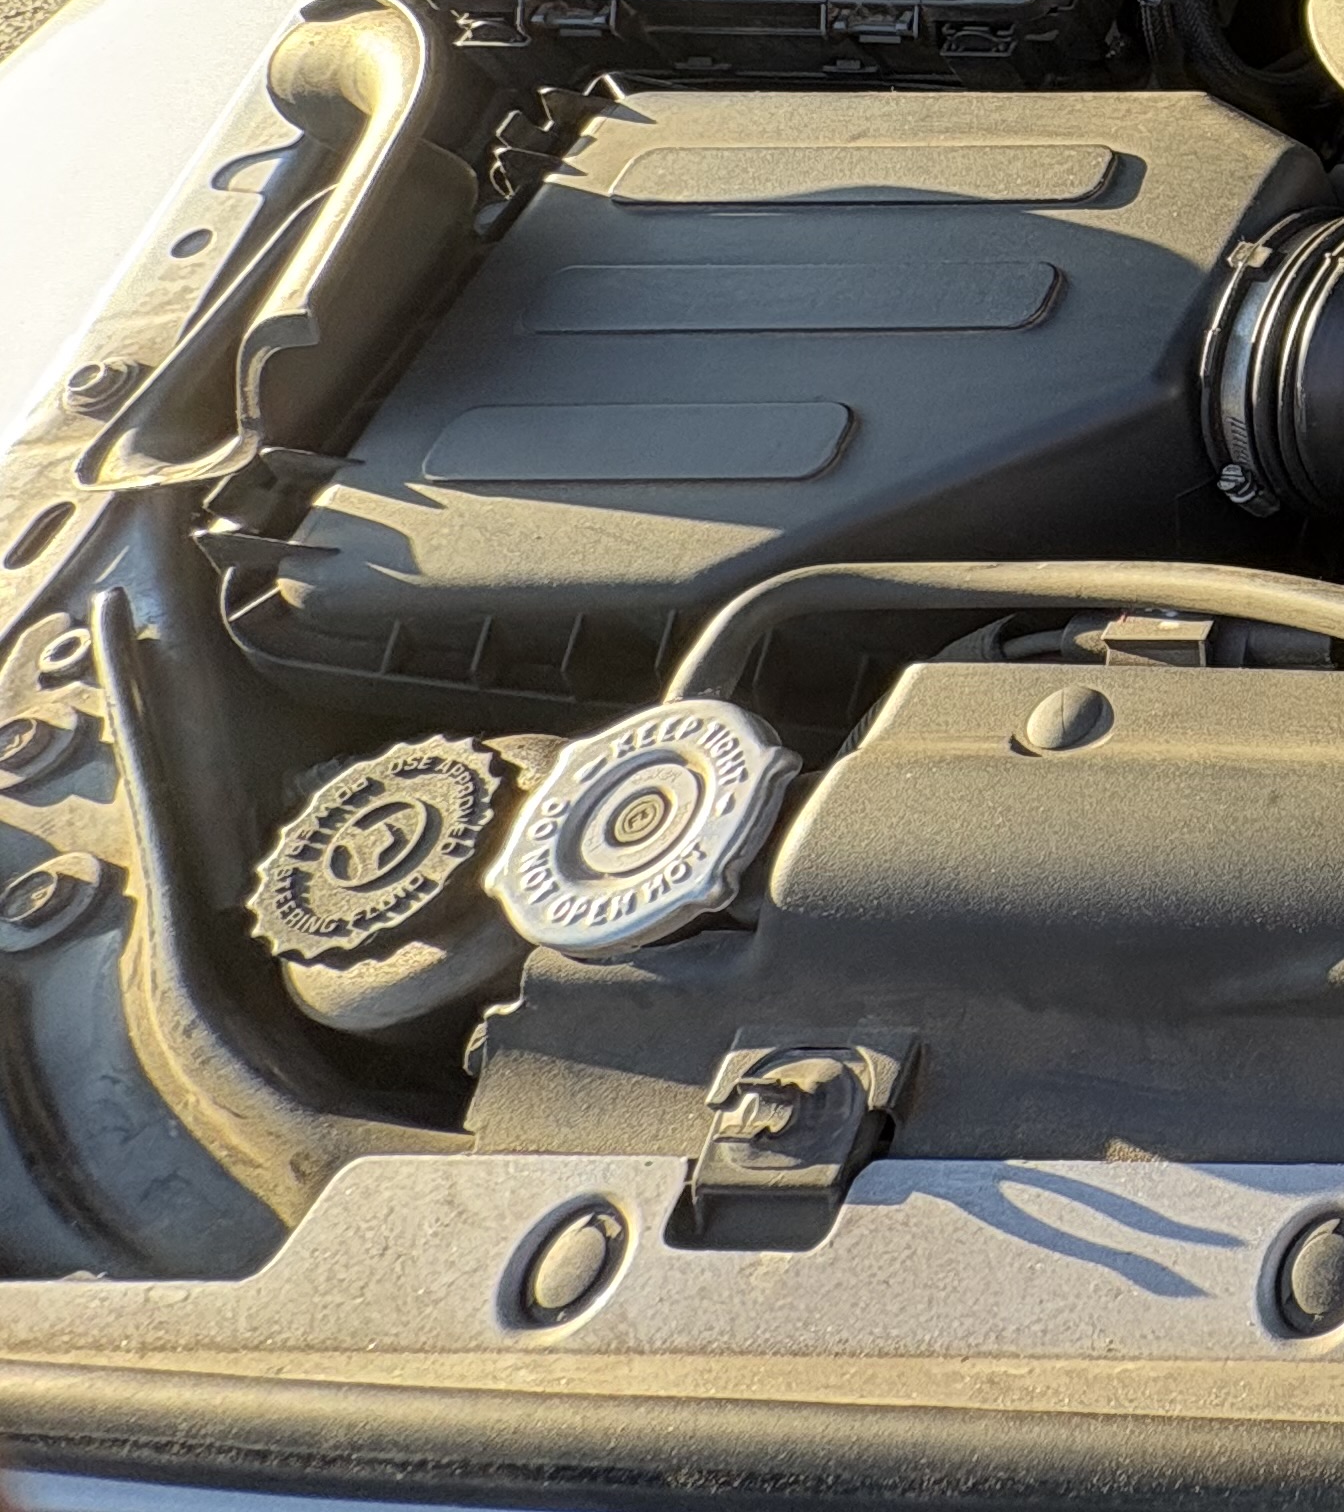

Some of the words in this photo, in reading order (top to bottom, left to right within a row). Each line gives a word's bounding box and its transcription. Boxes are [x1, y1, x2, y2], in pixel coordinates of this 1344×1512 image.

[610, 715, 701, 759] KEEP
[698, 719, 748, 786] TIGHT
[387, 755, 434, 776] USE
[434, 759, 475, 855] APPROVED
[527, 797, 570, 838] DO
[271, 867, 339, 934] STEERING
[347, 872, 426, 930] FLUID
[520, 848, 558, 905] NOT
[641, 840, 705, 903] HOT
[548, 890, 637, 927] OPEN
